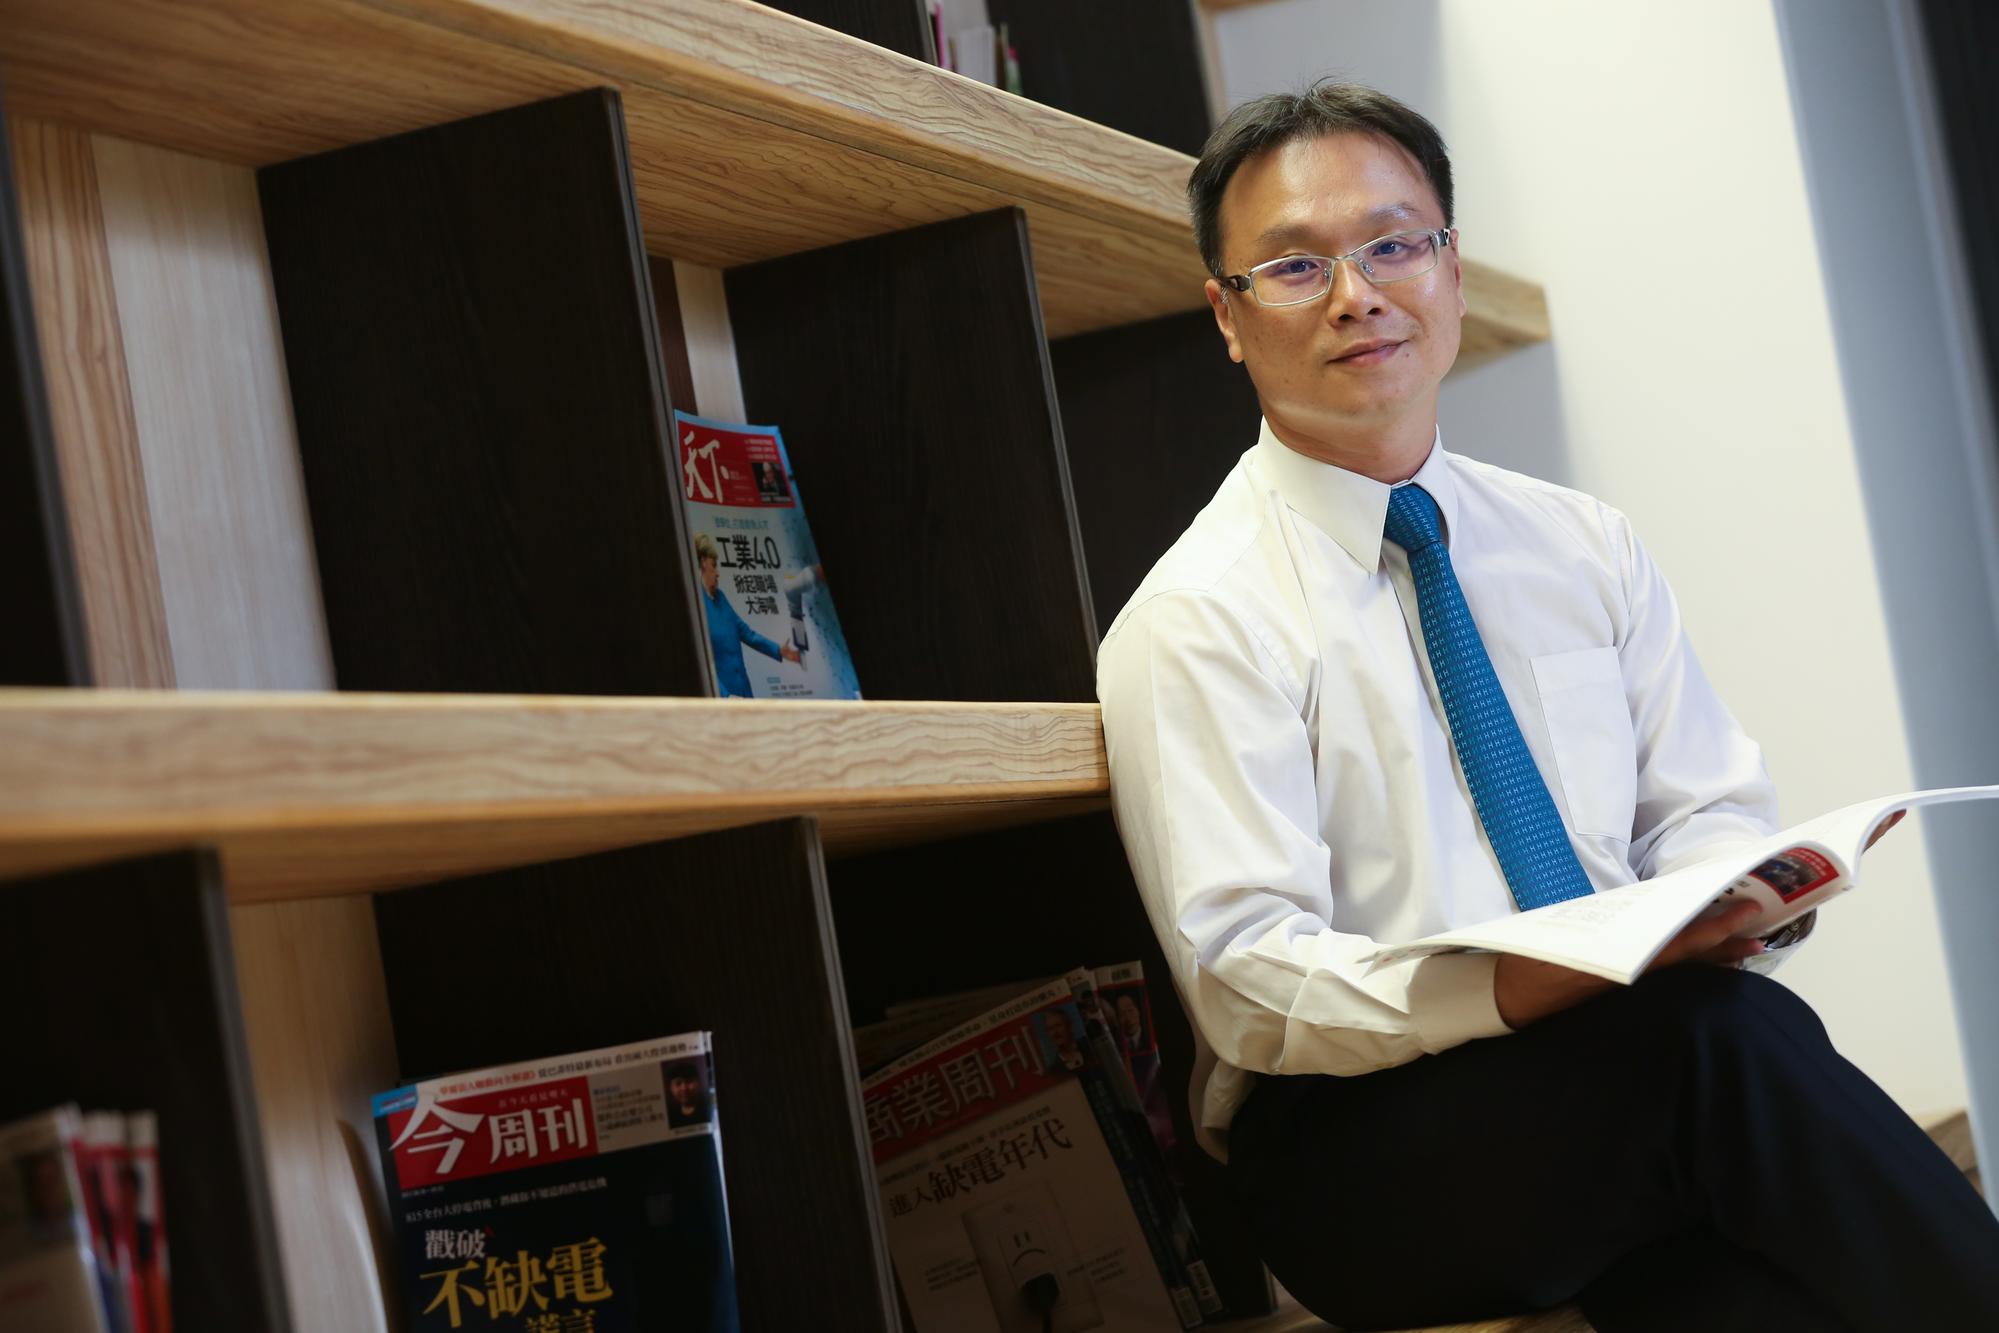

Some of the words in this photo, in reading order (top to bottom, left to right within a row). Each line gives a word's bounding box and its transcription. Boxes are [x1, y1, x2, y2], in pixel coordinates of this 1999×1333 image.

[716, 534, 781, 570] 工業4.0
[389, 1086, 589, 1175] 今周刊
[425, 1229, 486, 1260] 戳破
[419, 1237, 614, 1329] 不缺電
